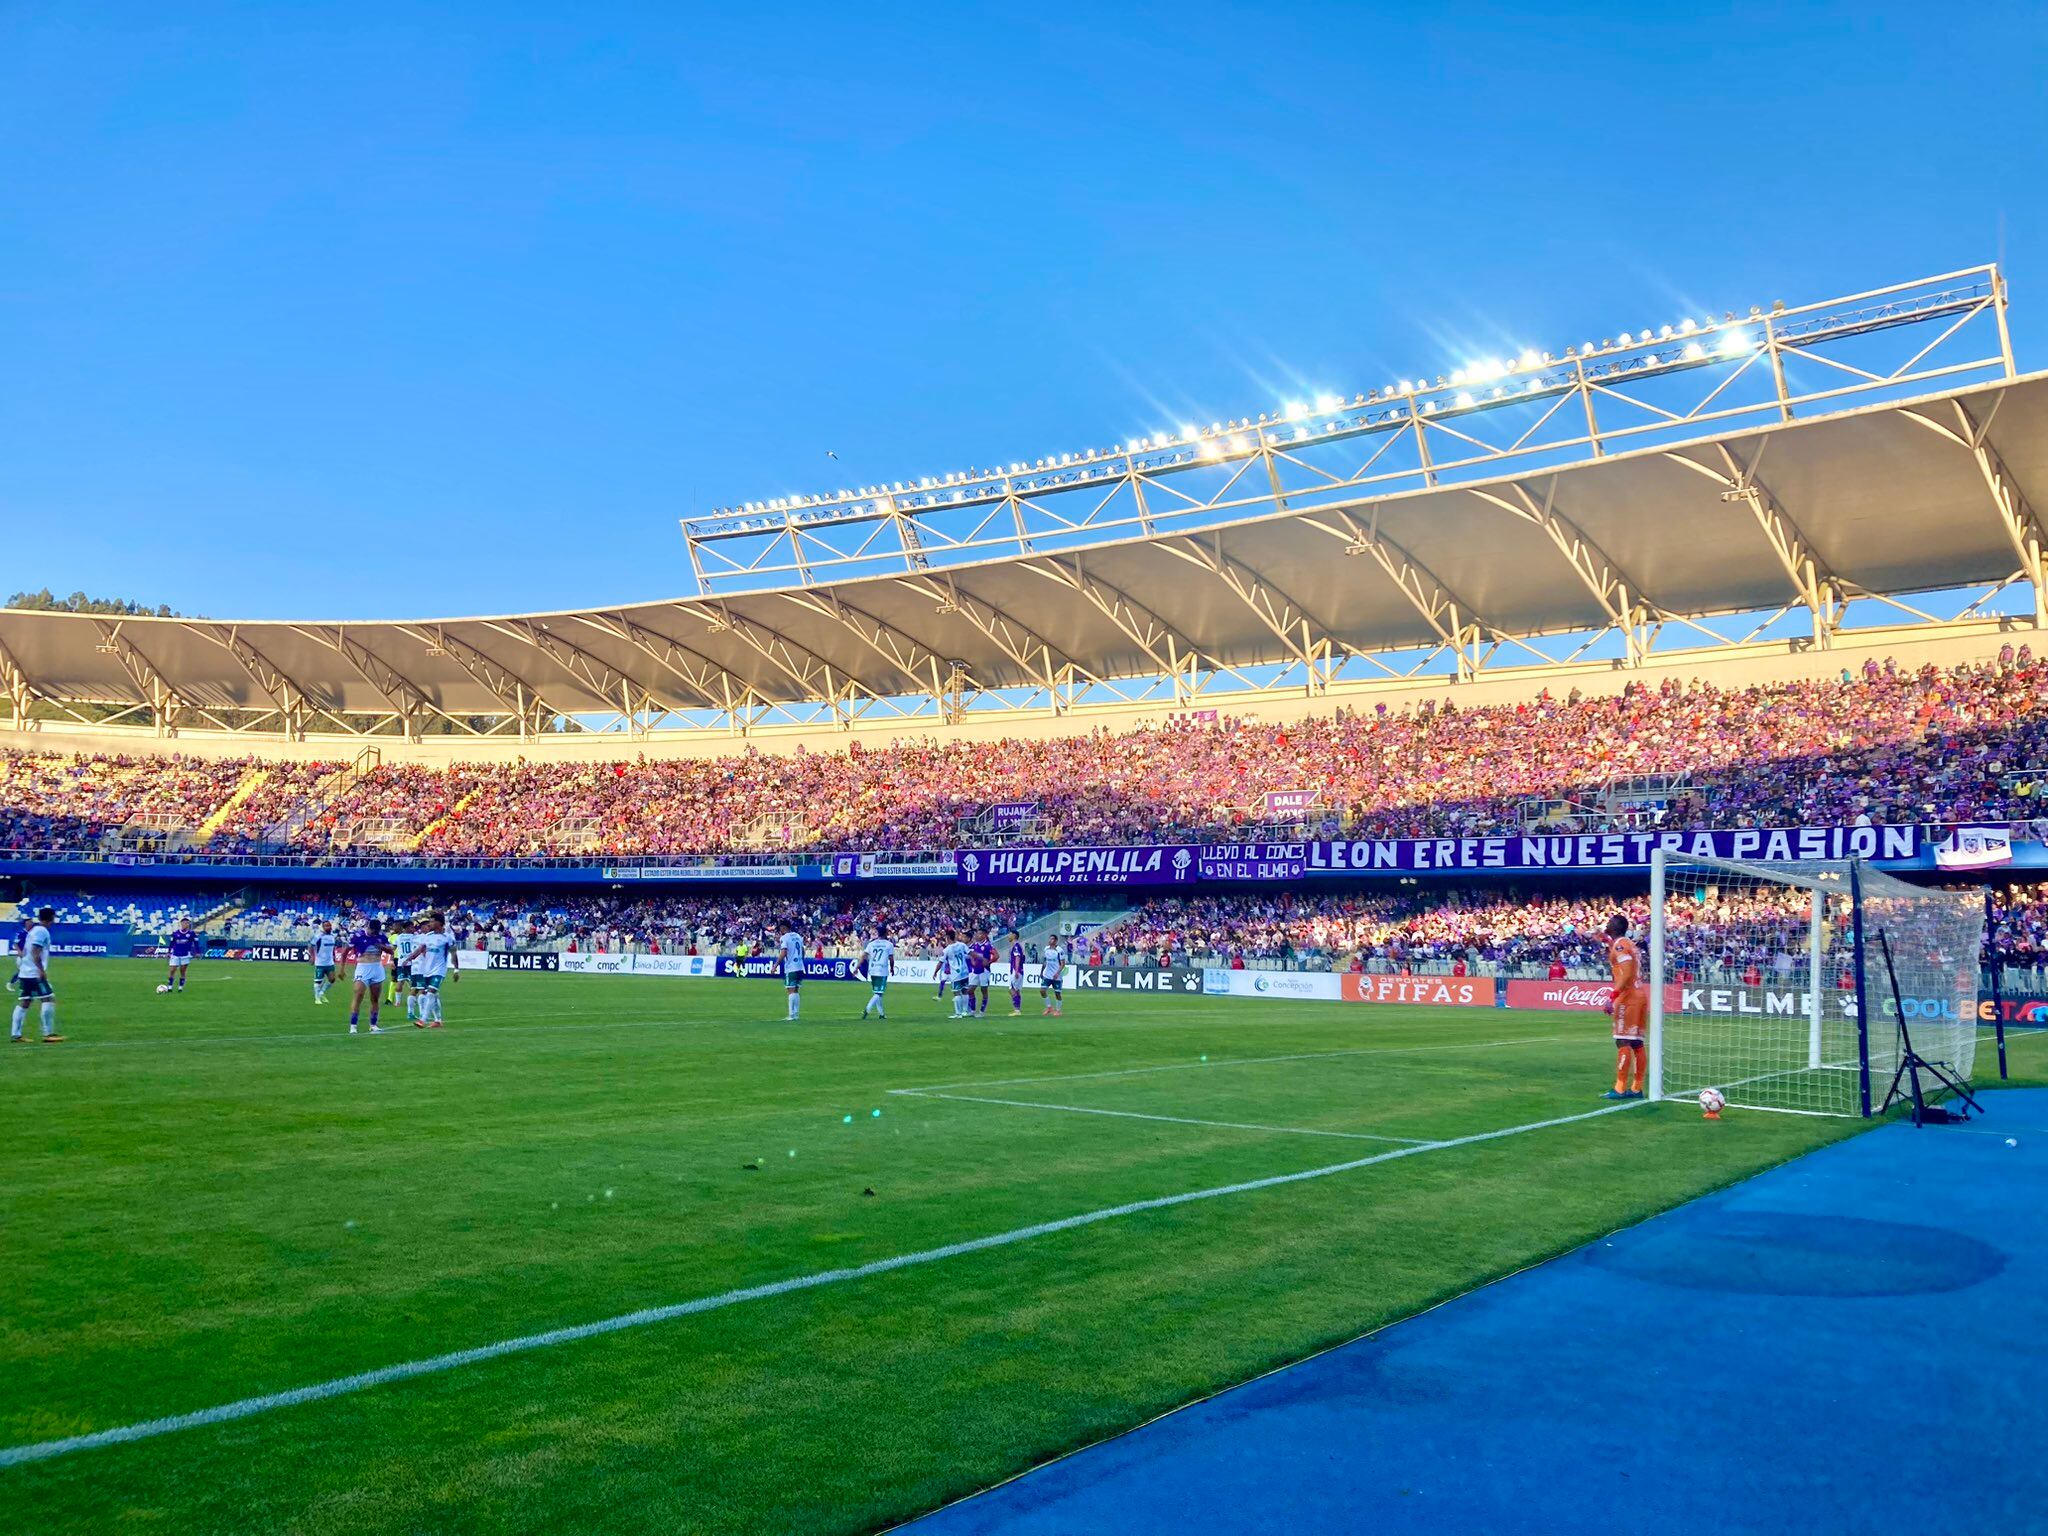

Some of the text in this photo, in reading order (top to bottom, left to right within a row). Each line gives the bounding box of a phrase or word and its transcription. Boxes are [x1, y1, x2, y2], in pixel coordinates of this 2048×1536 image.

[1274, 795, 1303, 806] DALE
[997, 806, 1026, 817] RUJAN
[1202, 845, 1239, 860] LLEVO
[1244, 845, 1260, 860] AL
[1311, 841, 1397, 868] LEON
[1414, 837, 1506, 868] ERES
[1521, 832, 1716, 866] NUESTRA
[989, 849, 1163, 874] HUALPENLILA
[1216, 863, 1289, 878] EN EL ALMA
[1016, 873, 1128, 883] COMUNA DEL LEON
[252, 947, 299, 960] KELME
[401, 941, 412, 954] 10
[488, 954, 542, 969] KELME
[872, 948, 883, 962] 27
[597, 960, 620, 971] cmpc
[668, 960, 682, 971] Sur
[807, 964, 830, 975] LIGA
[911, 965, 927, 977] Sur
[1026, 972, 1041, 983] cm
[1078, 969, 1173, 990] KELME
[1379, 977, 1443, 985] DEPORTES
[1543, 989, 1562, 1001] mi
[1681, 988, 1824, 1016] KELME
[1882, 997, 2017, 1021] COOLBET
